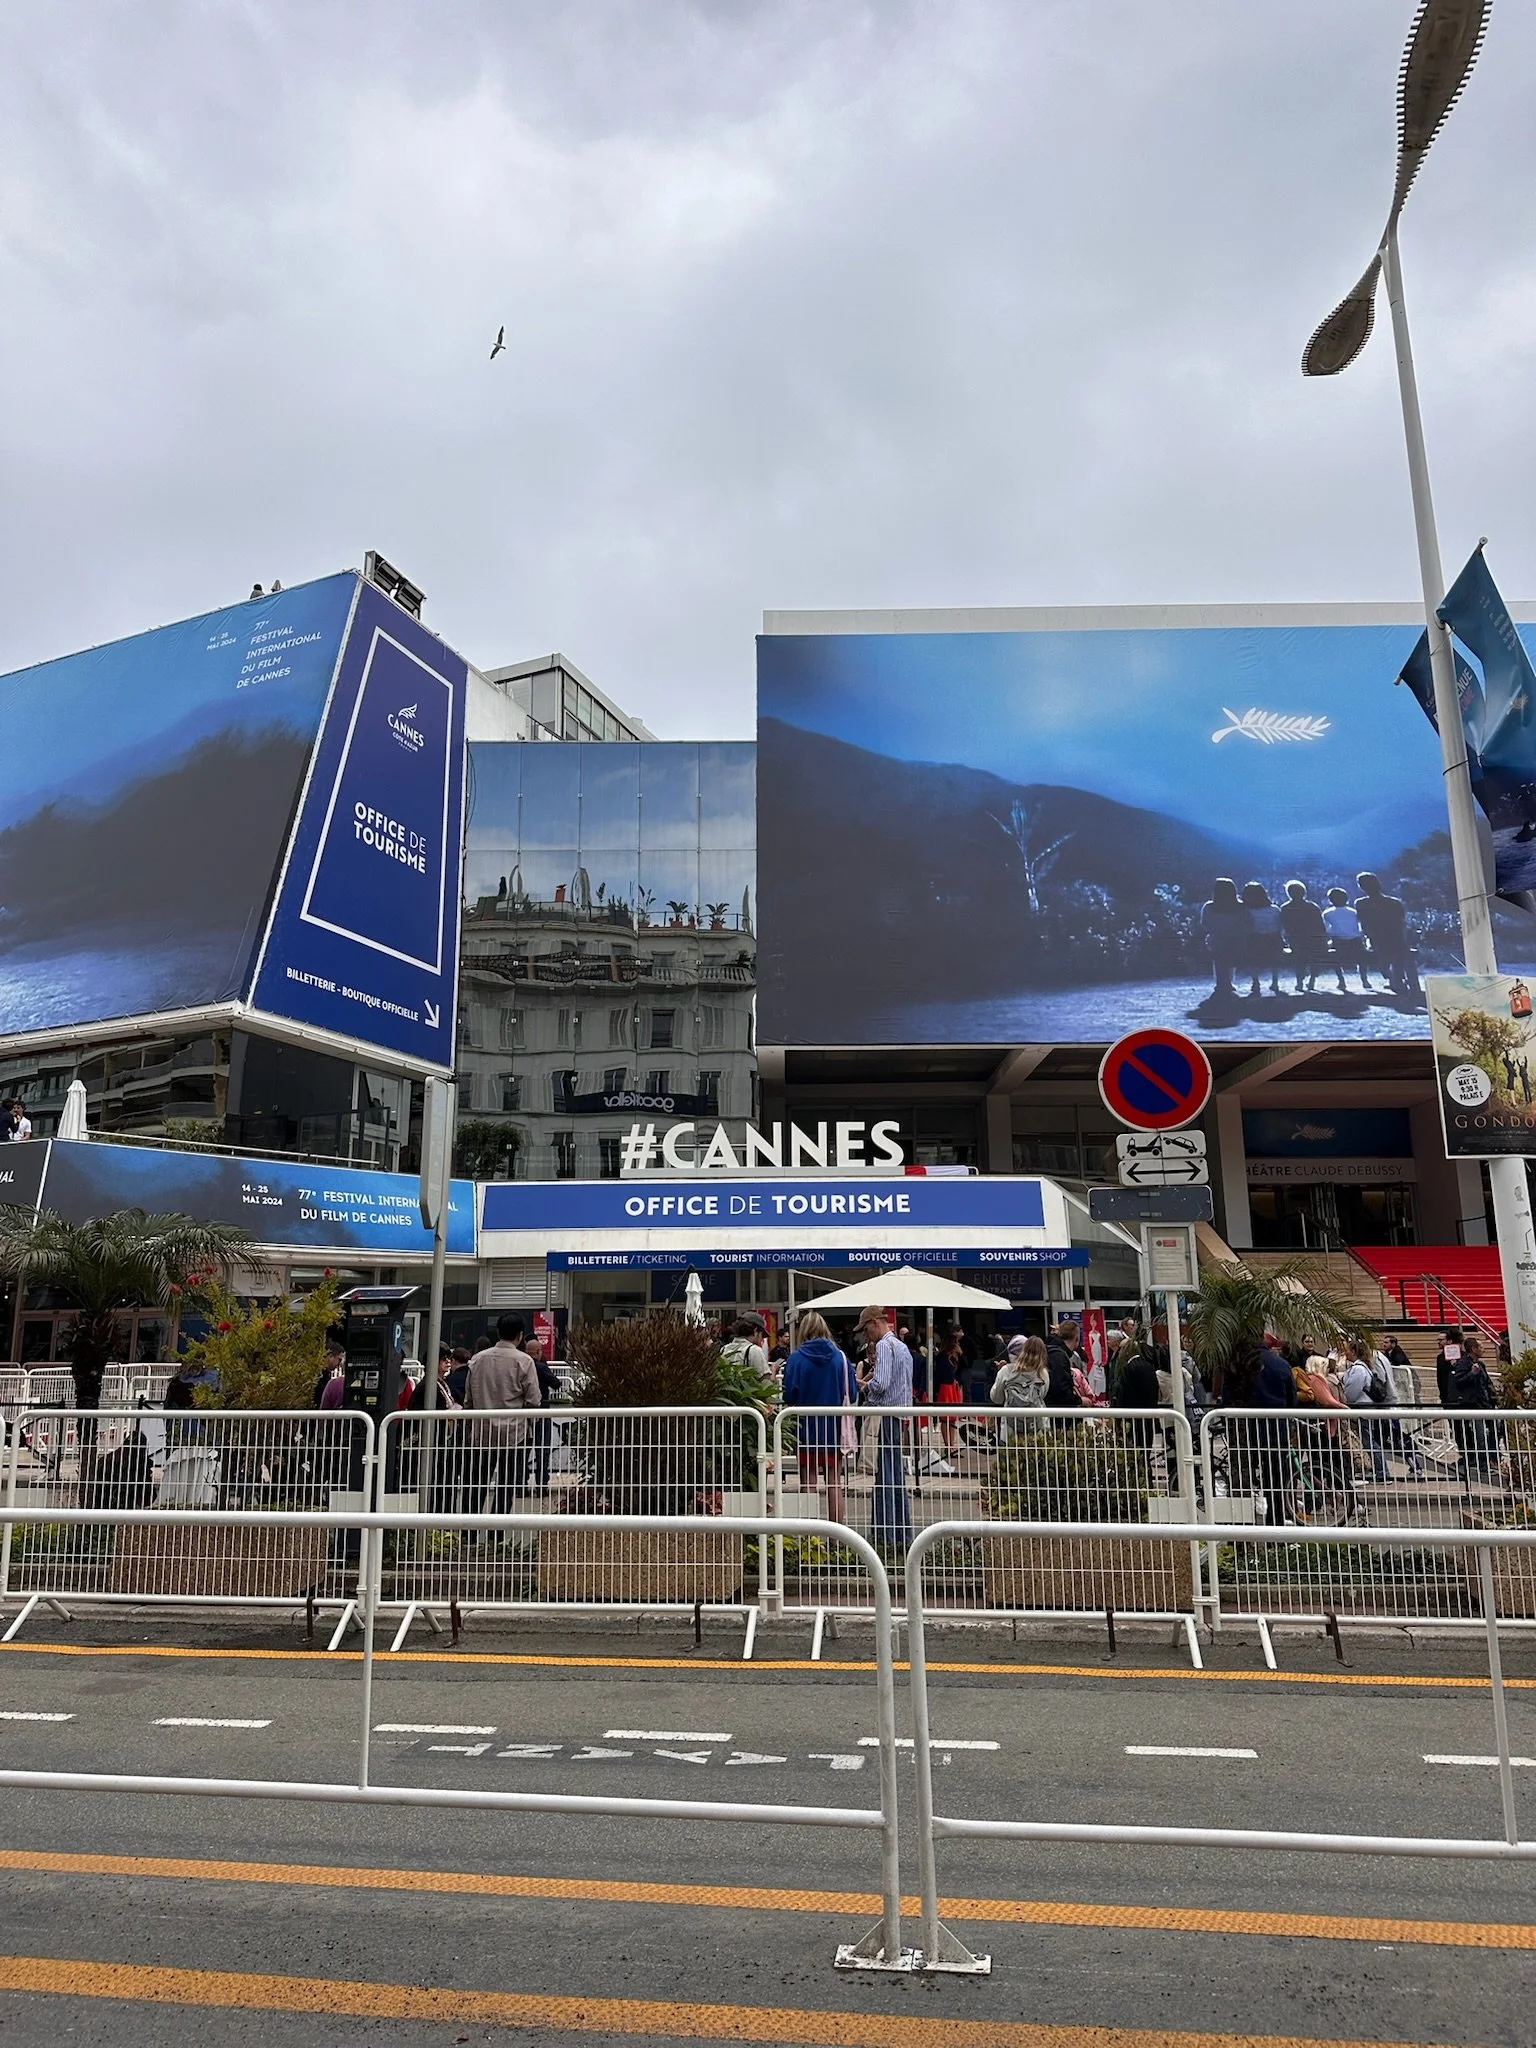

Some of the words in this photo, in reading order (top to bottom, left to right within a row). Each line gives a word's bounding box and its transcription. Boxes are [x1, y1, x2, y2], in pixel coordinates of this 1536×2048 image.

[207, 642, 219, 651] MAI
[220, 637, 237, 647] 2024
[250, 626, 294, 645] FESTIVAL
[246, 632, 322, 660] INTERNATIONAL
[241, 664, 255, 674] DU
[258, 656, 282, 670] FILM
[236, 678, 250, 688] DE
[252, 667, 291, 684] CANNES
[387, 713, 424, 747] CANNES
[355, 802, 406, 843] OFFICE
[410, 831, 427, 854] DE
[354, 821, 426, 874] TOURISME
[286, 967, 336, 993] BILLETTERIE
[342, 986, 381, 1008] BOUTIQUE
[382, 1001, 419, 1022] OFFICIELLE
[621, 1120, 905, 1169] #CANNES
[1294, 1165, 1344, 1176] CLAUDE
[1348, 1165, 1403, 1176] DEBUSSY
[242, 1184, 251, 1192] 14
[257, 1185, 268, 1194] 25
[242, 1195, 260, 1204] MAI
[262, 1196, 283, 1206] 2024
[324, 1191, 375, 1206] FESTIVAL
[625, 1195, 719, 1216] OFFICE
[730, 1195, 762, 1215] DE
[771, 1194, 911, 1215] TOURISME
[300, 1208, 317, 1220] DU
[321, 1209, 349, 1222] FILM
[352, 1212, 367, 1223] DE
[370, 1213, 412, 1226] CANNES
[568, 1255, 629, 1265] BILLETTERIE
[635, 1254, 688, 1264] TICKETING
[710, 1253, 754, 1263] TOURIST
[756, 1253, 826, 1263] INFORMATION
[849, 1252, 902, 1263] BOUTIQUE
[903, 1252, 958, 1262] OFFICIELLE
[980, 1252, 1038, 1262] SOUVENIRS
[1039, 1252, 1067, 1262] SHOP
[974, 1271, 1026, 1285] ENTRÉE
